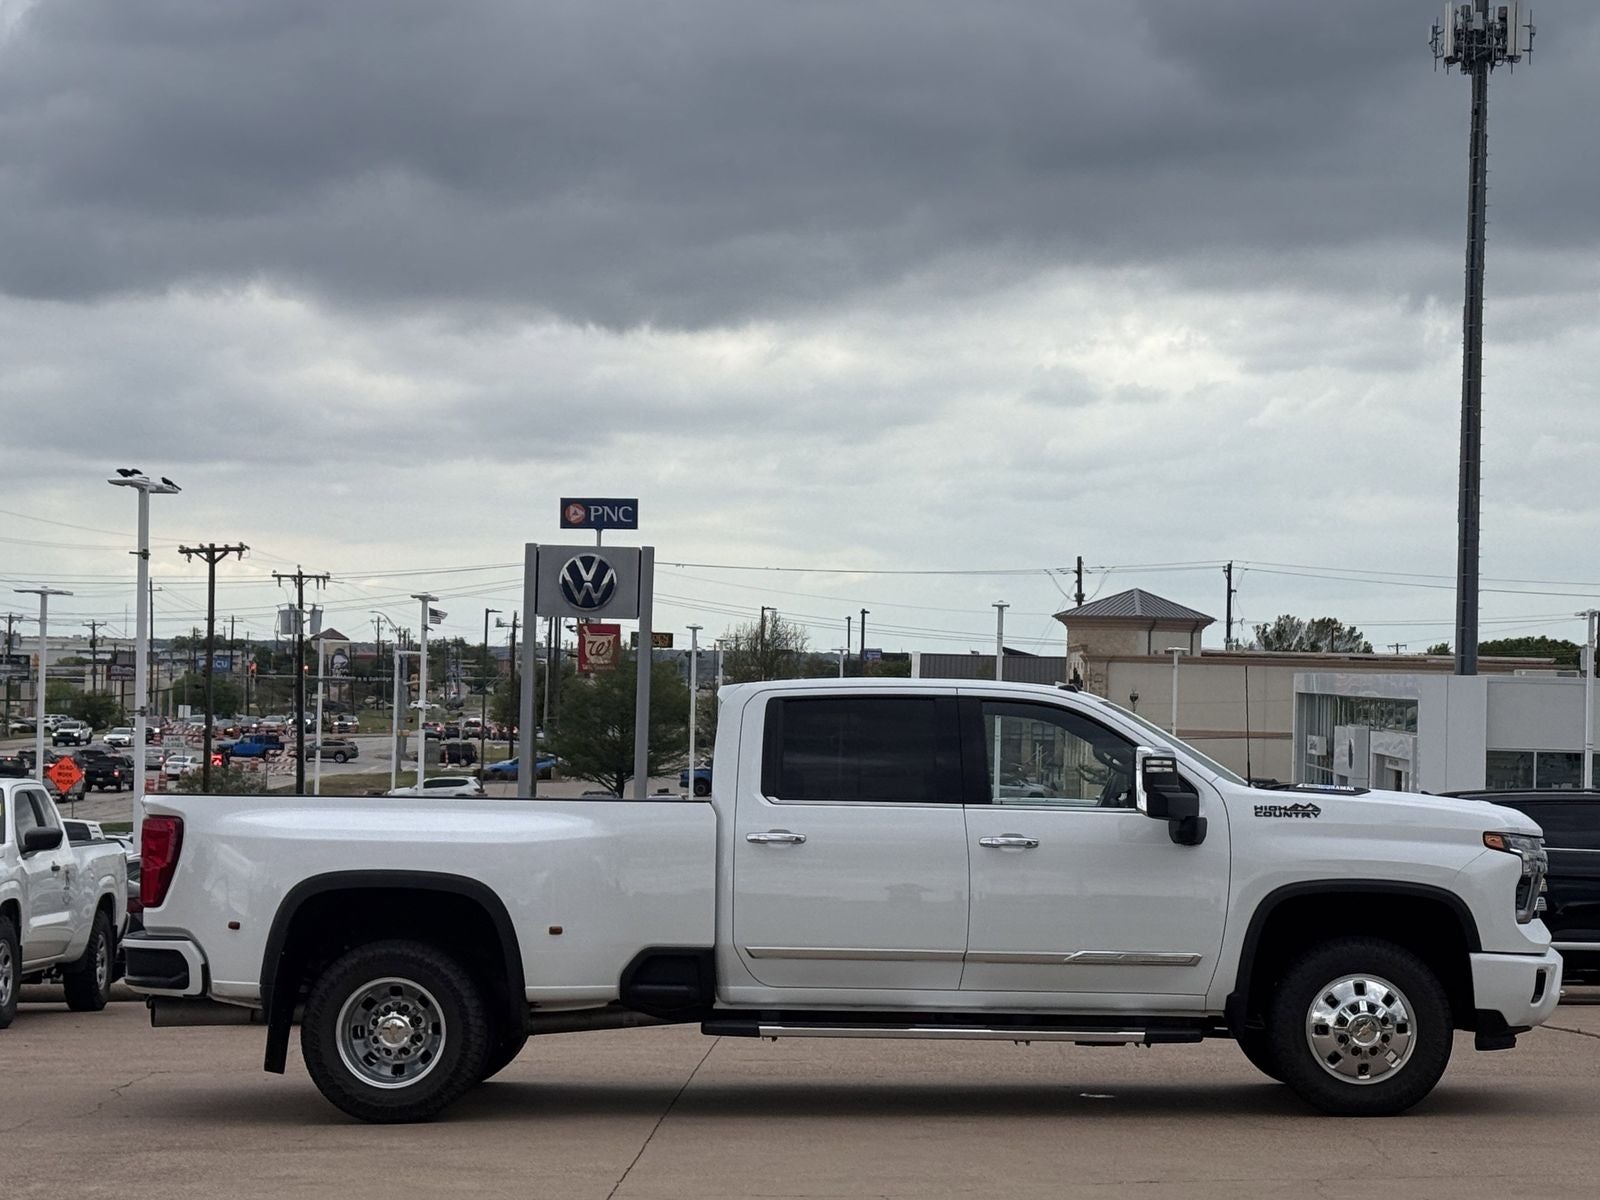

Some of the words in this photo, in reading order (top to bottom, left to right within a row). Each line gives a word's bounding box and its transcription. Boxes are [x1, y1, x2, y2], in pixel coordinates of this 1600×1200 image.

[589, 505, 633, 522] PNC
[559, 554, 616, 611] VW
[1253, 810, 1321, 819] COUNTRY
